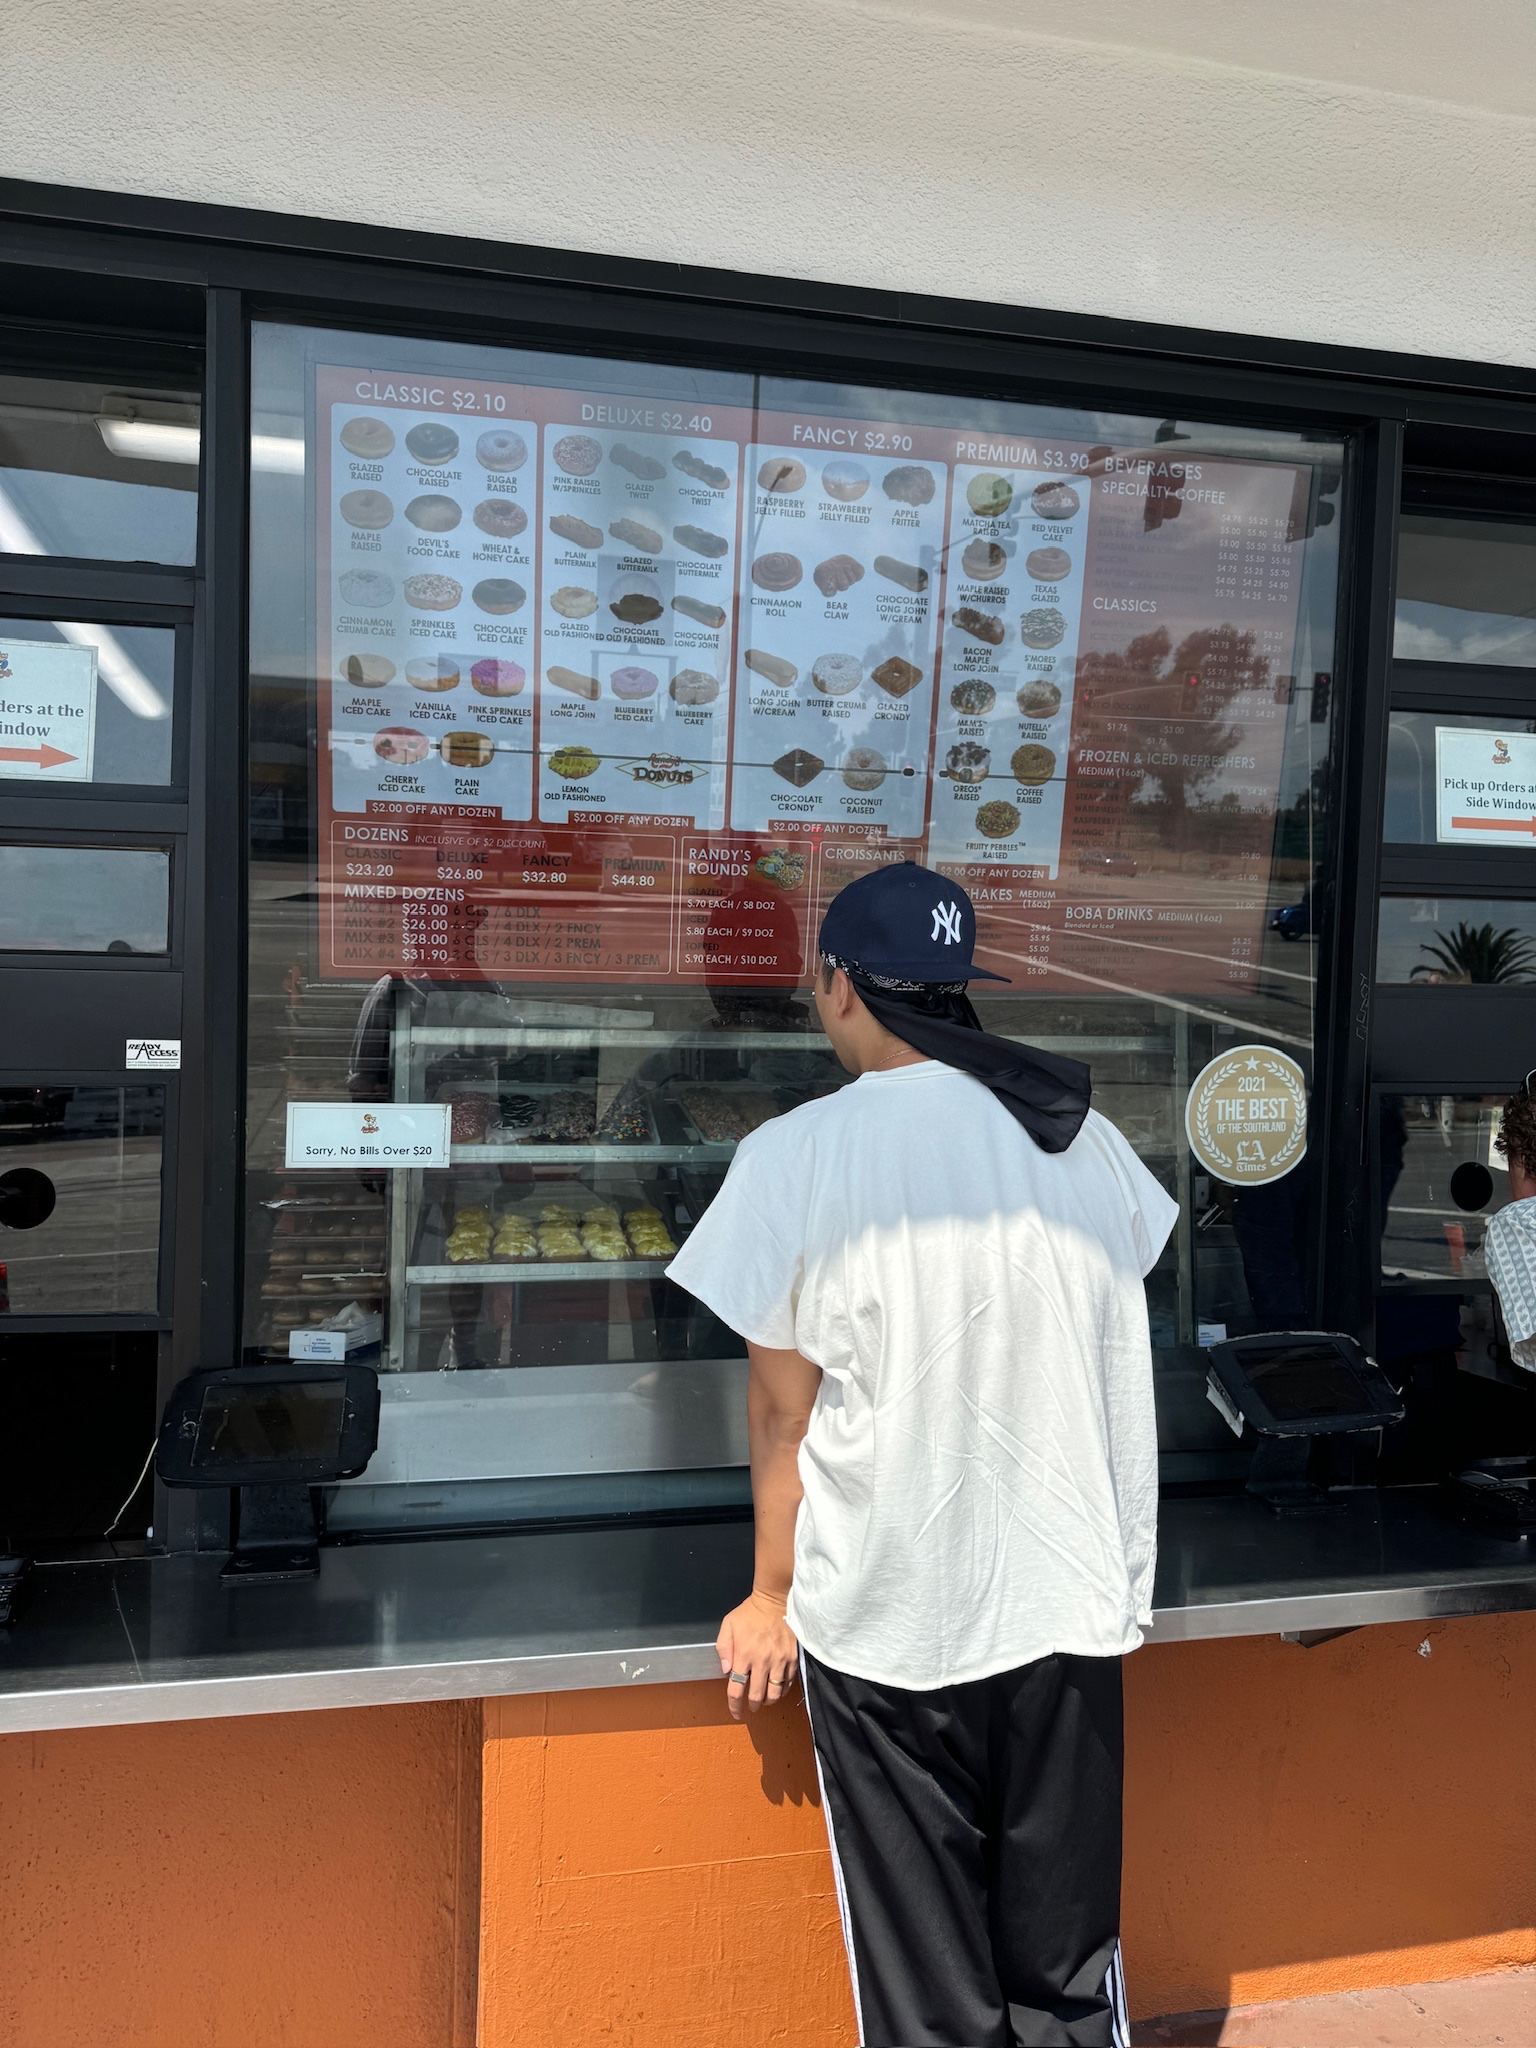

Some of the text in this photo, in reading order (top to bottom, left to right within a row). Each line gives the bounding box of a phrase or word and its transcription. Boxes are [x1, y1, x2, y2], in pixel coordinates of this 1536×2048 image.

[356, 382, 505, 411] CLASSIC $2.10
[582, 404, 711, 432] DELUXE $2.40
[794, 425, 912, 451] FANCY $2.90
[956, 442, 1088, 469] PREMIUM $3.90
[407, 468, 462, 480] CHOCOLATE
[1104, 457, 1202, 480] BEVERAGES
[487, 475, 517, 484] SUGAR
[553, 484, 601, 495] W/SPRINKLES
[679, 488, 724, 498] CHOCOLATE
[1102, 481, 1225, 504] SPECIALTY COFFEE
[755, 506, 805, 518] JELLY FILLED
[962, 518, 1010, 529] MATCHA TEA
[418, 538, 449, 548] DEVIL'S
[473, 553, 530, 564] HONEY CAKE
[624, 557, 652, 565] GLAZED
[617, 564, 658, 573] BUTTERMILK
[1035, 585, 1057, 593] TEXAS
[877, 605, 927, 615] LONG JOHN
[1093, 597, 1157, 613] CLASSICS
[474, 624, 527, 635] CHOCOLATE
[613, 627, 659, 636] CHOCOLATE
[478, 633, 524, 644] ICED CAKE
[624, 635, 665, 645] FASHIONED
[963, 647, 991, 655] BACON
[1025, 655, 1056, 663] S'MORES
[761, 689, 789, 697] MAPLE
[561, 703, 585, 711] MAPLE
[776, 699, 800, 707] JOHN
[37, 705, 53, 715] at
[58, 704, 84, 717] the
[410, 711, 457, 720] ICED CAKE
[574, 711, 595, 719] JOHN
[477, 715, 523, 725] ICED CAKE
[1080, 750, 1255, 769] FROZEN & ICED REFRESHERS
[1078, 767, 1114, 776] MEDIUM
[455, 779, 479, 787] PLAIN
[1444, 778, 1468, 790] Pick
[1471, 782, 1484, 793] up
[1488, 780, 1526, 792] Orders
[455, 787, 479, 796] CAKE
[562, 794, 606, 802] FASHIONED
[1466, 797, 1489, 808] Side
[778, 803, 814, 811] CRONDY
[344, 827, 546, 848] DOZENS INCLUSIVE OF $2 DISCOUNT
[344, 847, 570, 867] CLASSIC DELUXE FANCY
[690, 848, 751, 861] RANDY'S
[825, 848, 905, 860] CROISSANTS
[605, 858, 665, 872] PREMIUM
[689, 863, 748, 876] ROUNDS
[346, 863, 567, 884] $23.20 $26.80 $32.80
[967, 868, 986, 876] OFF
[989, 869, 1009, 877] ANY
[1012, 870, 1044, 879] DOZEN
[612, 874, 654, 886] $44.80
[344, 885, 464, 901] MIXED DOZENS
[1020, 890, 1055, 898] MEDIUM
[402, 903, 448, 915] $25.00
[709, 900, 733, 909] EACH
[743, 901, 753, 910] $8
[756, 902, 775, 910] DOZ
[1023, 900, 1051, 909] (16oz)
[1066, 907, 1102, 920] BOBA
[1107, 908, 1153, 921] DRINKS
[1158, 913, 1193, 921] MEDIUM
[402, 919, 448, 931] $26.00
[402, 934, 447, 946] $28.00
[706, 955, 731, 964] EACH
[741, 956, 755, 964] $10
[758, 957, 777, 965] DOZ
[1238, 1077, 1265, 1092] 2021
[1215, 1098, 1288, 1120] THE BEST
[1217, 1122, 1286, 1134] OF THE SOUTHLAND
[306, 1146, 432, 1156] Sorry, No Bills Over $20
[1237, 1140, 1266, 1161] LA
[1236, 1162, 1266, 1172] Times
